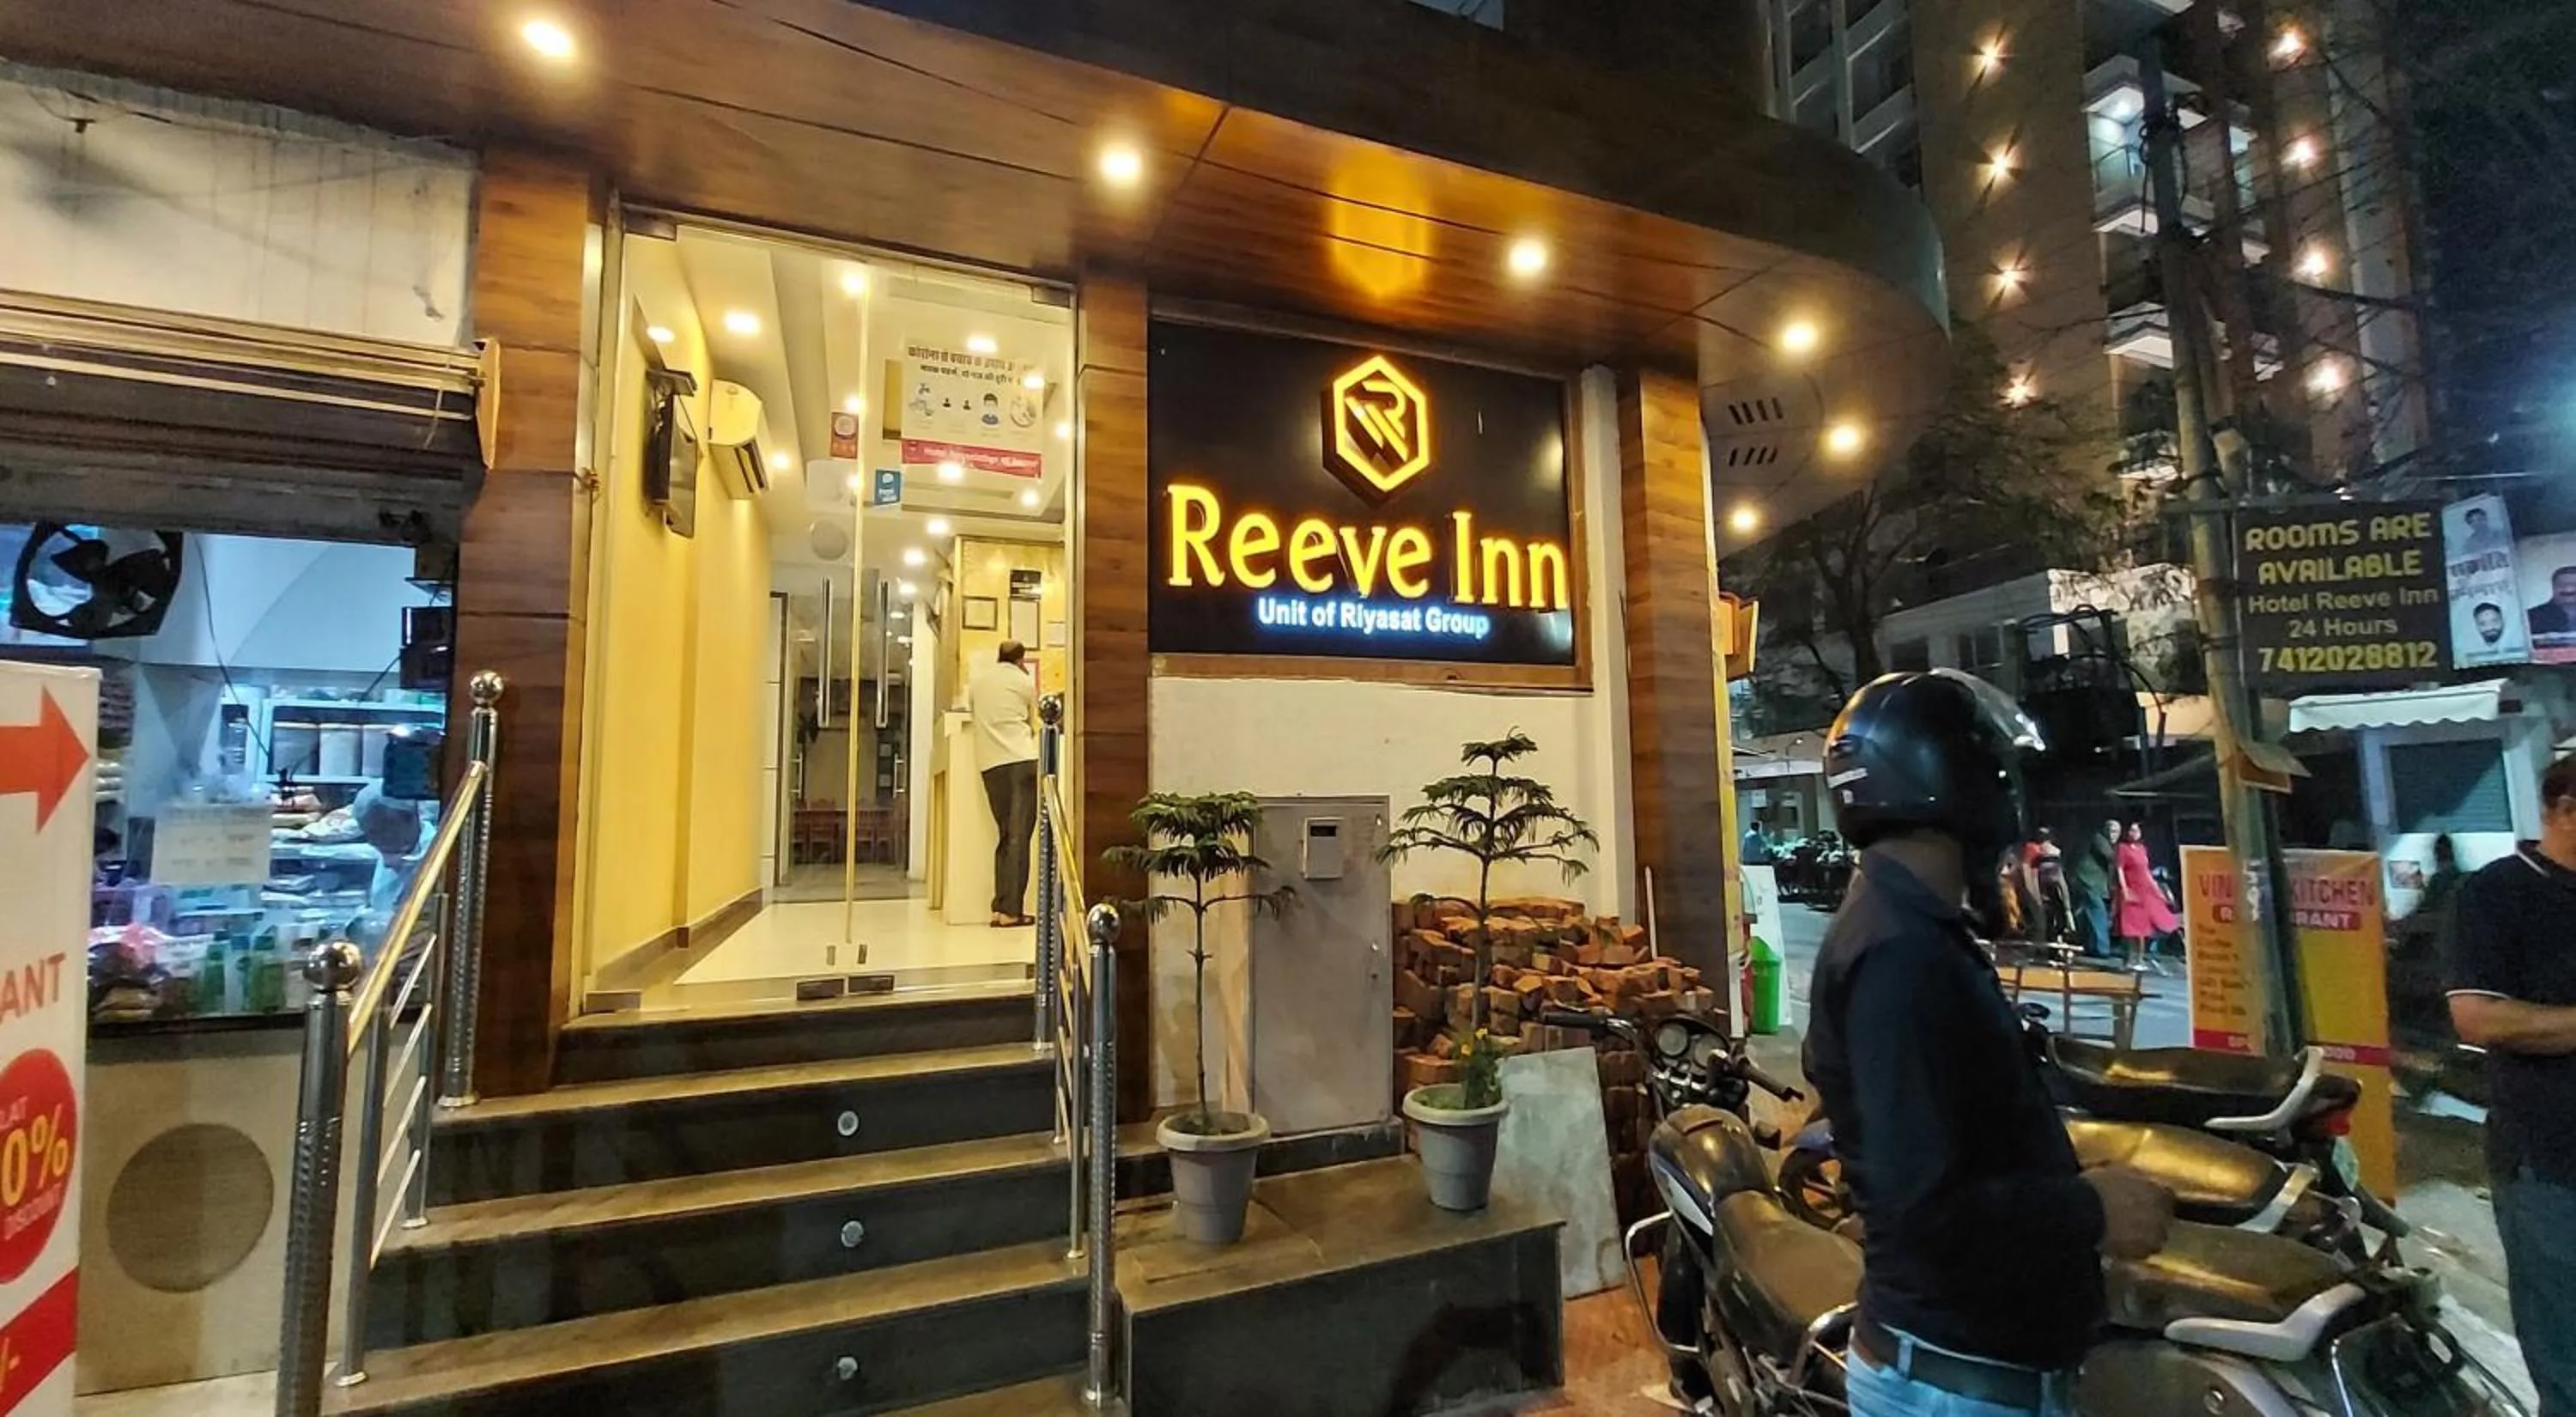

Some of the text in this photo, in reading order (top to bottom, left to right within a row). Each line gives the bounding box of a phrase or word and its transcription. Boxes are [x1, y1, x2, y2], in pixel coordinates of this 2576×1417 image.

[1167, 484, 1567, 609] Reeve Inn
[2245, 513, 2432, 551] ROOMS ARE
[2258, 550, 2423, 586] AVAILABLE
[2249, 590, 2308, 614] Hotel
[2316, 592, 2391, 611] Reeve
[2398, 586, 2438, 605] Inn
[1258, 598, 1491, 640] Unit of Riyasat Group
[2289, 617, 2398, 639] 24 Hours
[2258, 641, 2438, 673] 7412028812
